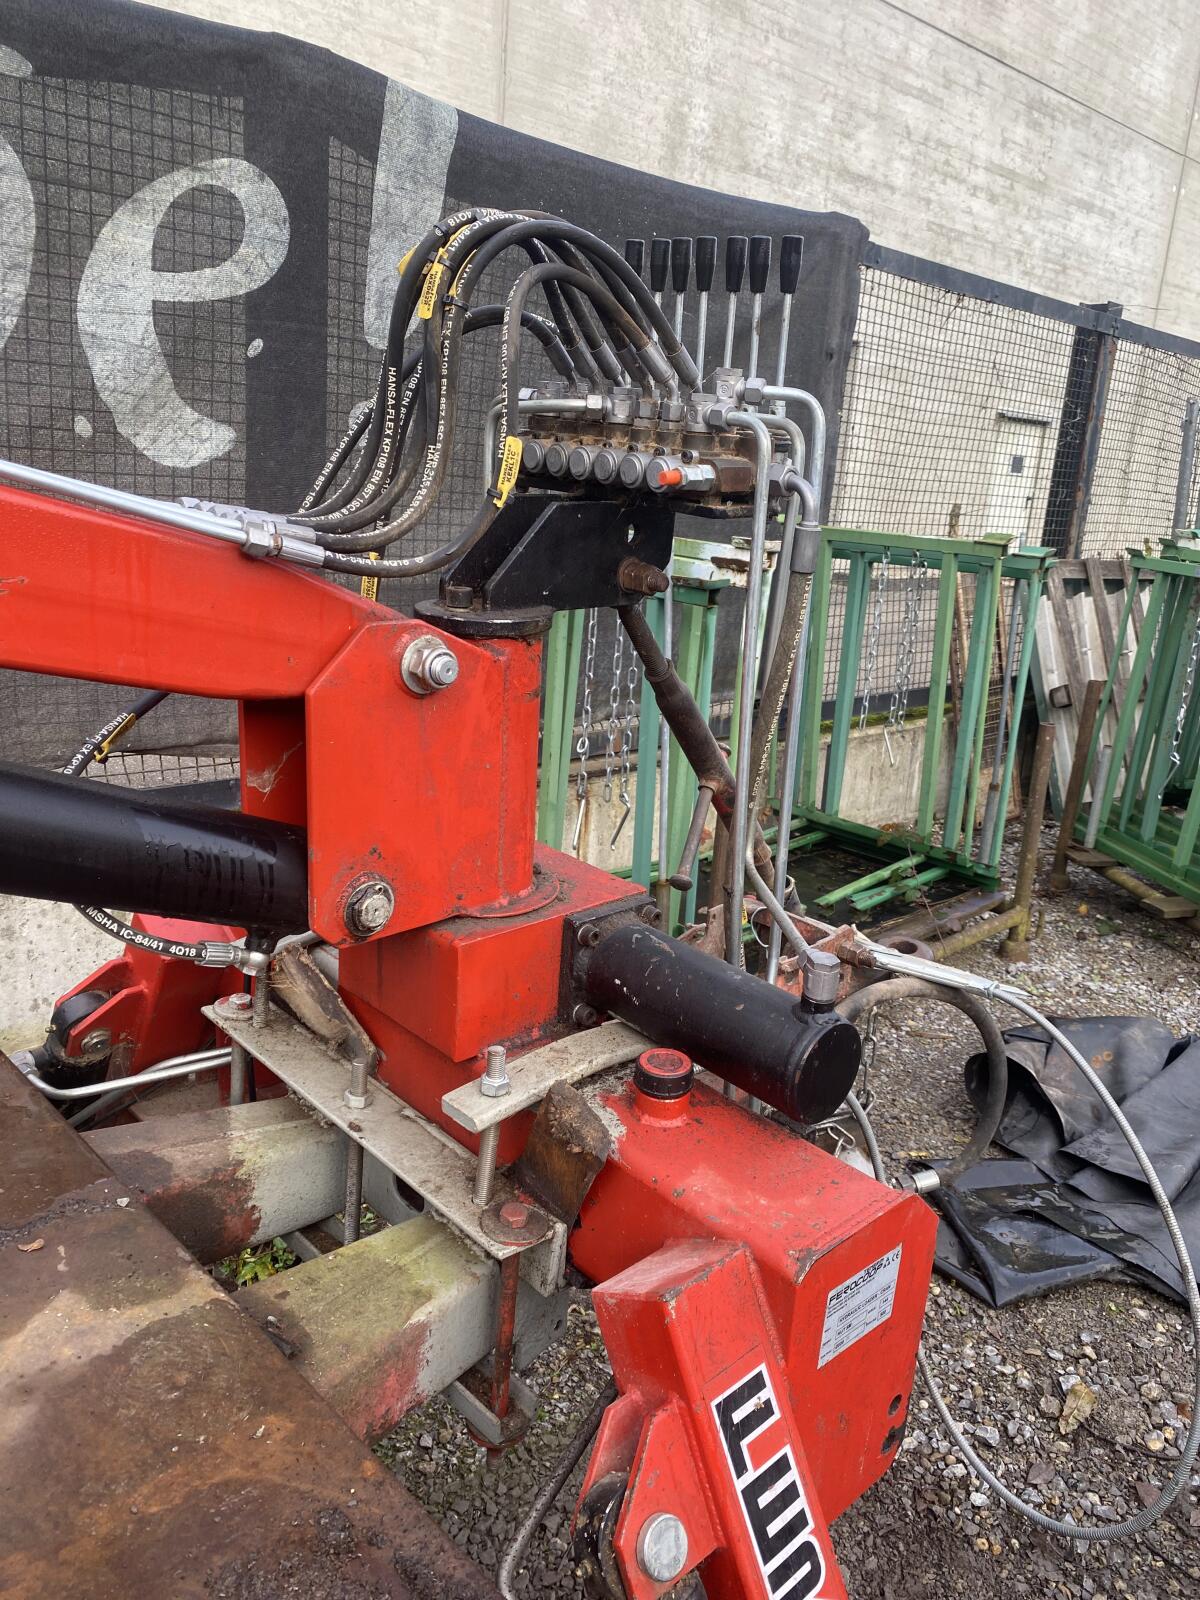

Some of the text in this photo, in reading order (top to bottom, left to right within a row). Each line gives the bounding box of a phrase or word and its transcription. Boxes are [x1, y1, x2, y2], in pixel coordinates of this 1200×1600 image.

[447, 210, 472, 227] 4Q18
[502, 324, 509, 341] EN
[440, 378, 447, 395] EN
[384, 366, 397, 436] HANSA-FLEX
[403, 388, 413, 406] EN
[498, 382, 509, 458] HANSA-FLEX
[331, 437, 350, 462] KP108
[376, 435, 393, 470] KP108
[322, 462, 333, 476] EN
[372, 470, 384, 485] EN
[313, 475, 325, 491] 857
[362, 483, 376, 499] 857
[302, 489, 316, 508] 1SC
[350, 498, 364, 512] 1SC
[343, 508, 350, 516] 8
[63, 753, 84, 775] KP10
[86, 906, 196, 957] MSHA IC-84/41 4Q18
